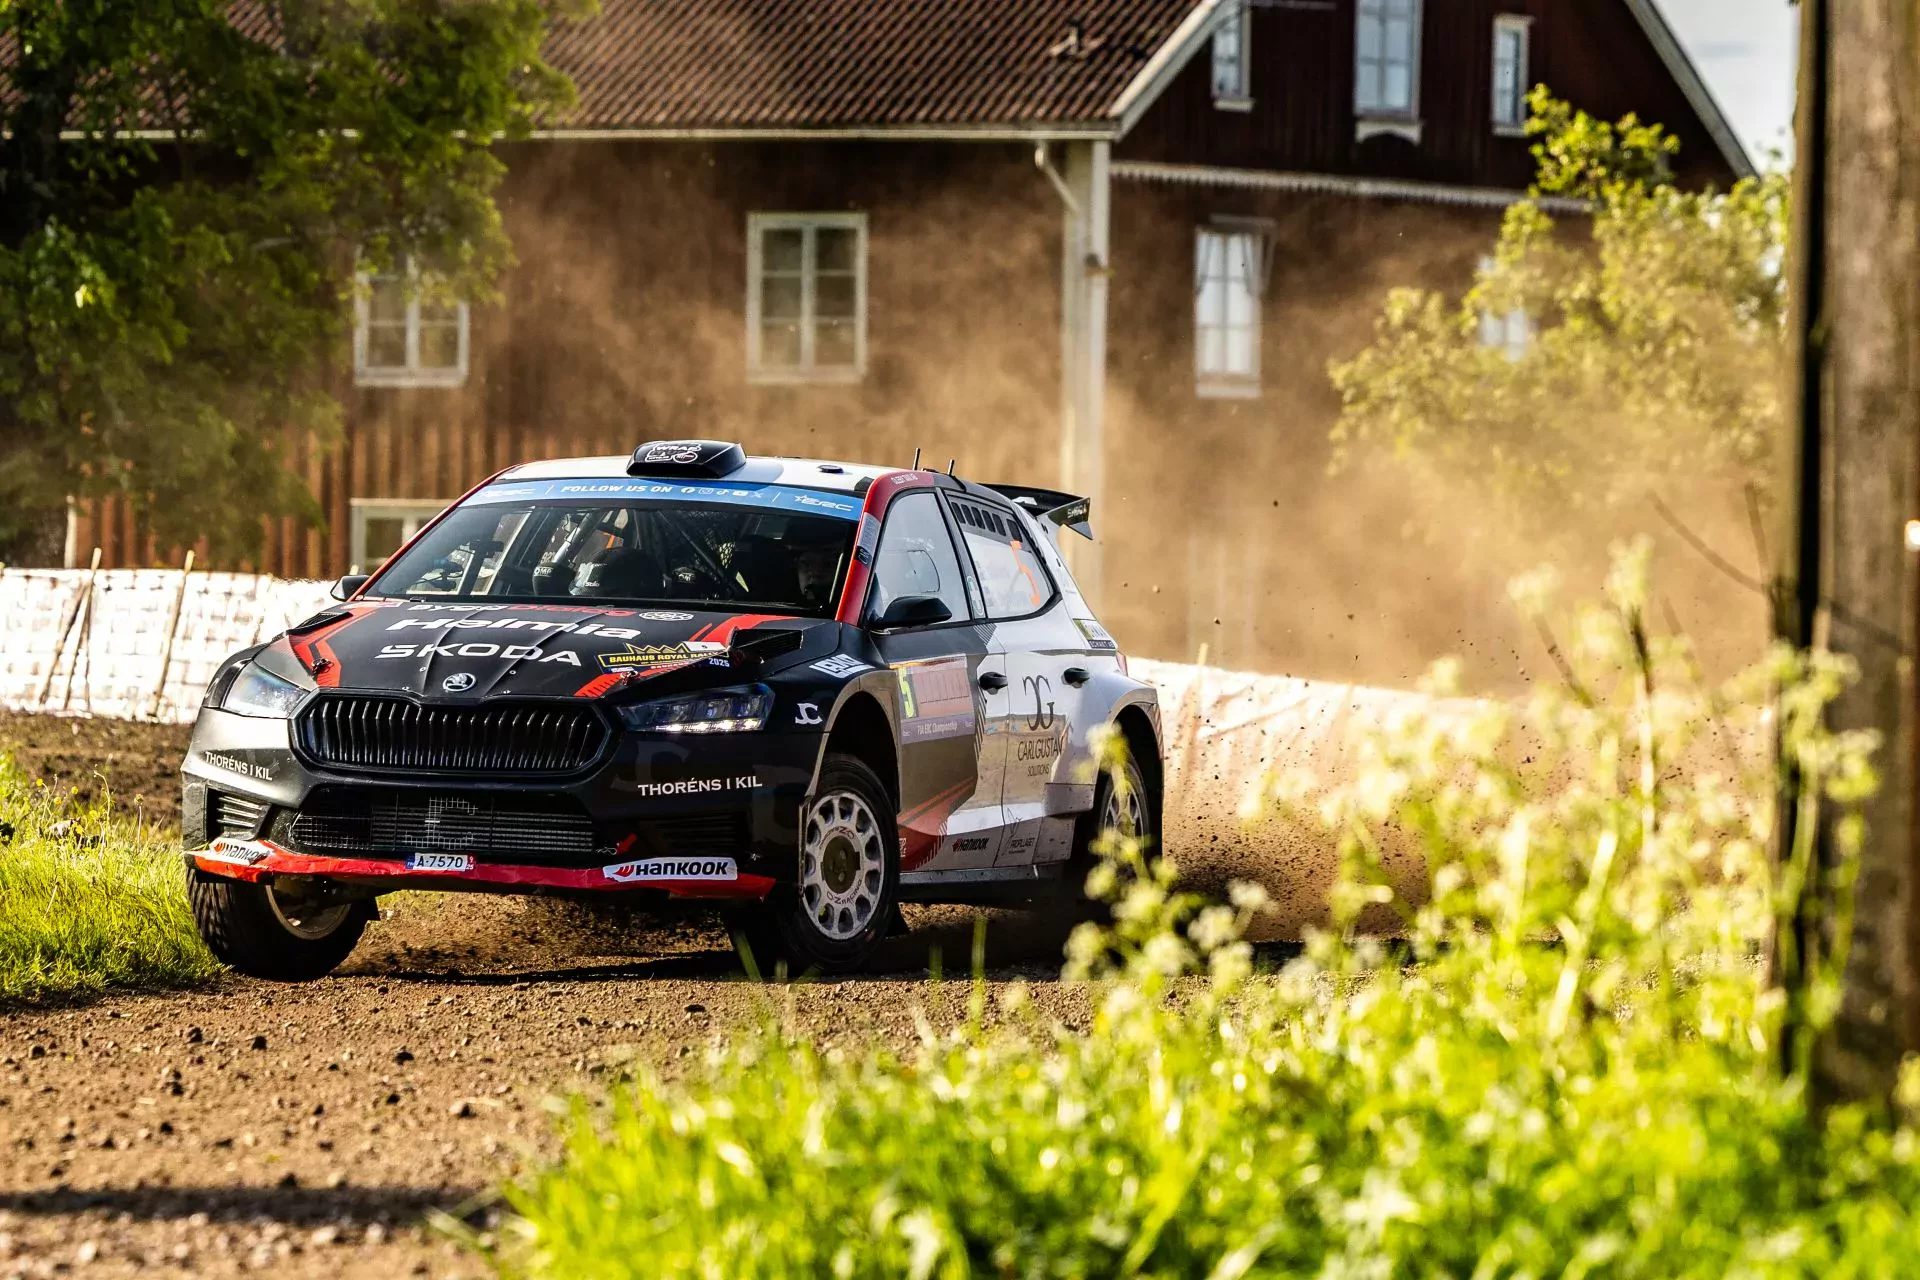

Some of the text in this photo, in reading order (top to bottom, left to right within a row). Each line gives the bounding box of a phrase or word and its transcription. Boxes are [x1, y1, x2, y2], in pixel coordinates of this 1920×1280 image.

[561, 485, 624, 493] FOLLOW
[625, 485, 646, 493] US
[385, 618, 642, 640] Helmia
[609, 654, 656, 663] BAUHAUS
[657, 653, 689, 661] ROYAL
[898, 667, 915, 718] 5
[205, 751, 248, 775] THORÉNS
[255, 765, 273, 781] KIL
[638, 775, 763, 796] THORÉNS I KIL
[416, 855, 464, 868] A-7570
